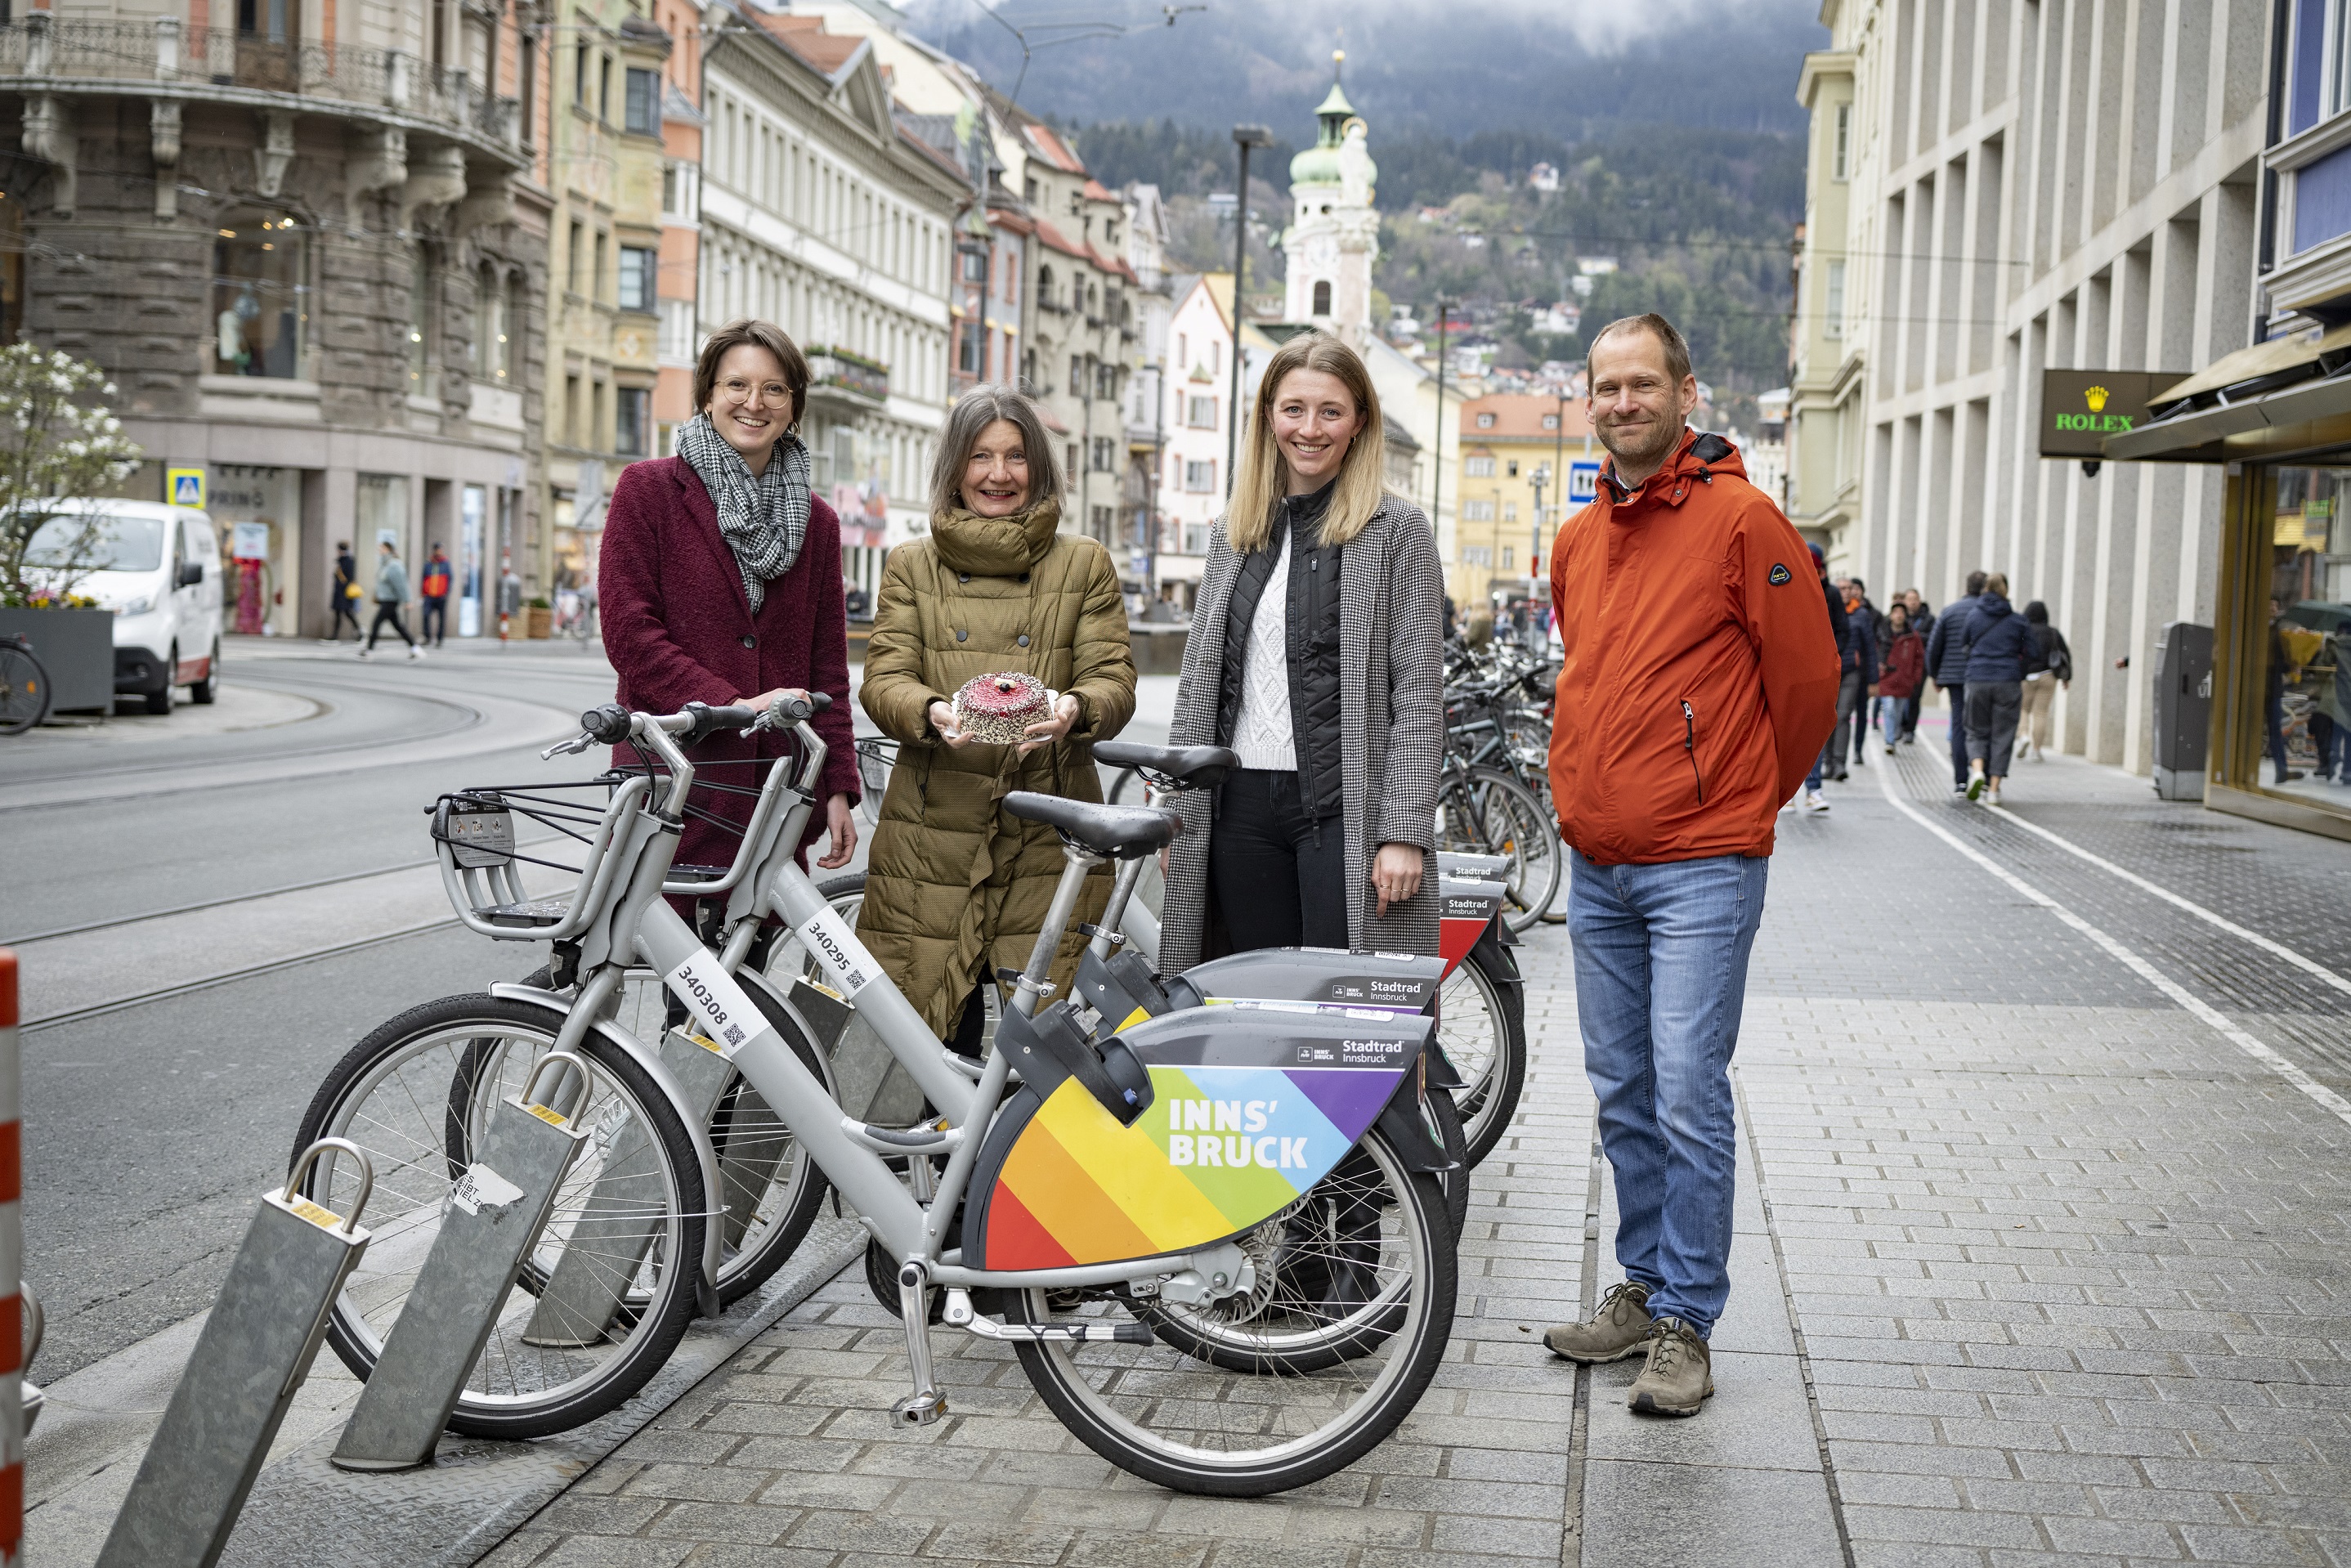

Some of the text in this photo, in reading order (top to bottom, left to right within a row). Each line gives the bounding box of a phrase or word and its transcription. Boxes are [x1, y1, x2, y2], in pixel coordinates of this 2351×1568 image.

[2056, 413, 2134, 432] ROLEX
[1292, 513, 1301, 557] UNTAINS
[1287, 602, 1296, 658] MOUNTAINS
[1294, 710, 1305, 768] MOUNTAINS
[1449, 899, 1488, 908] Stadtrad
[808, 922, 851, 970] 340295
[678, 966, 728, 1025] 340308
[1370, 992, 1407, 1001] Innsbruck
[1371, 981, 1421, 993] Stadtrad
[1342, 1040, 1403, 1053] Stadtrad
[1342, 1054, 1386, 1063] Innsbruck
[1170, 1099, 1278, 1133] INNS'
[1169, 1134, 1308, 1169] BRUCK
